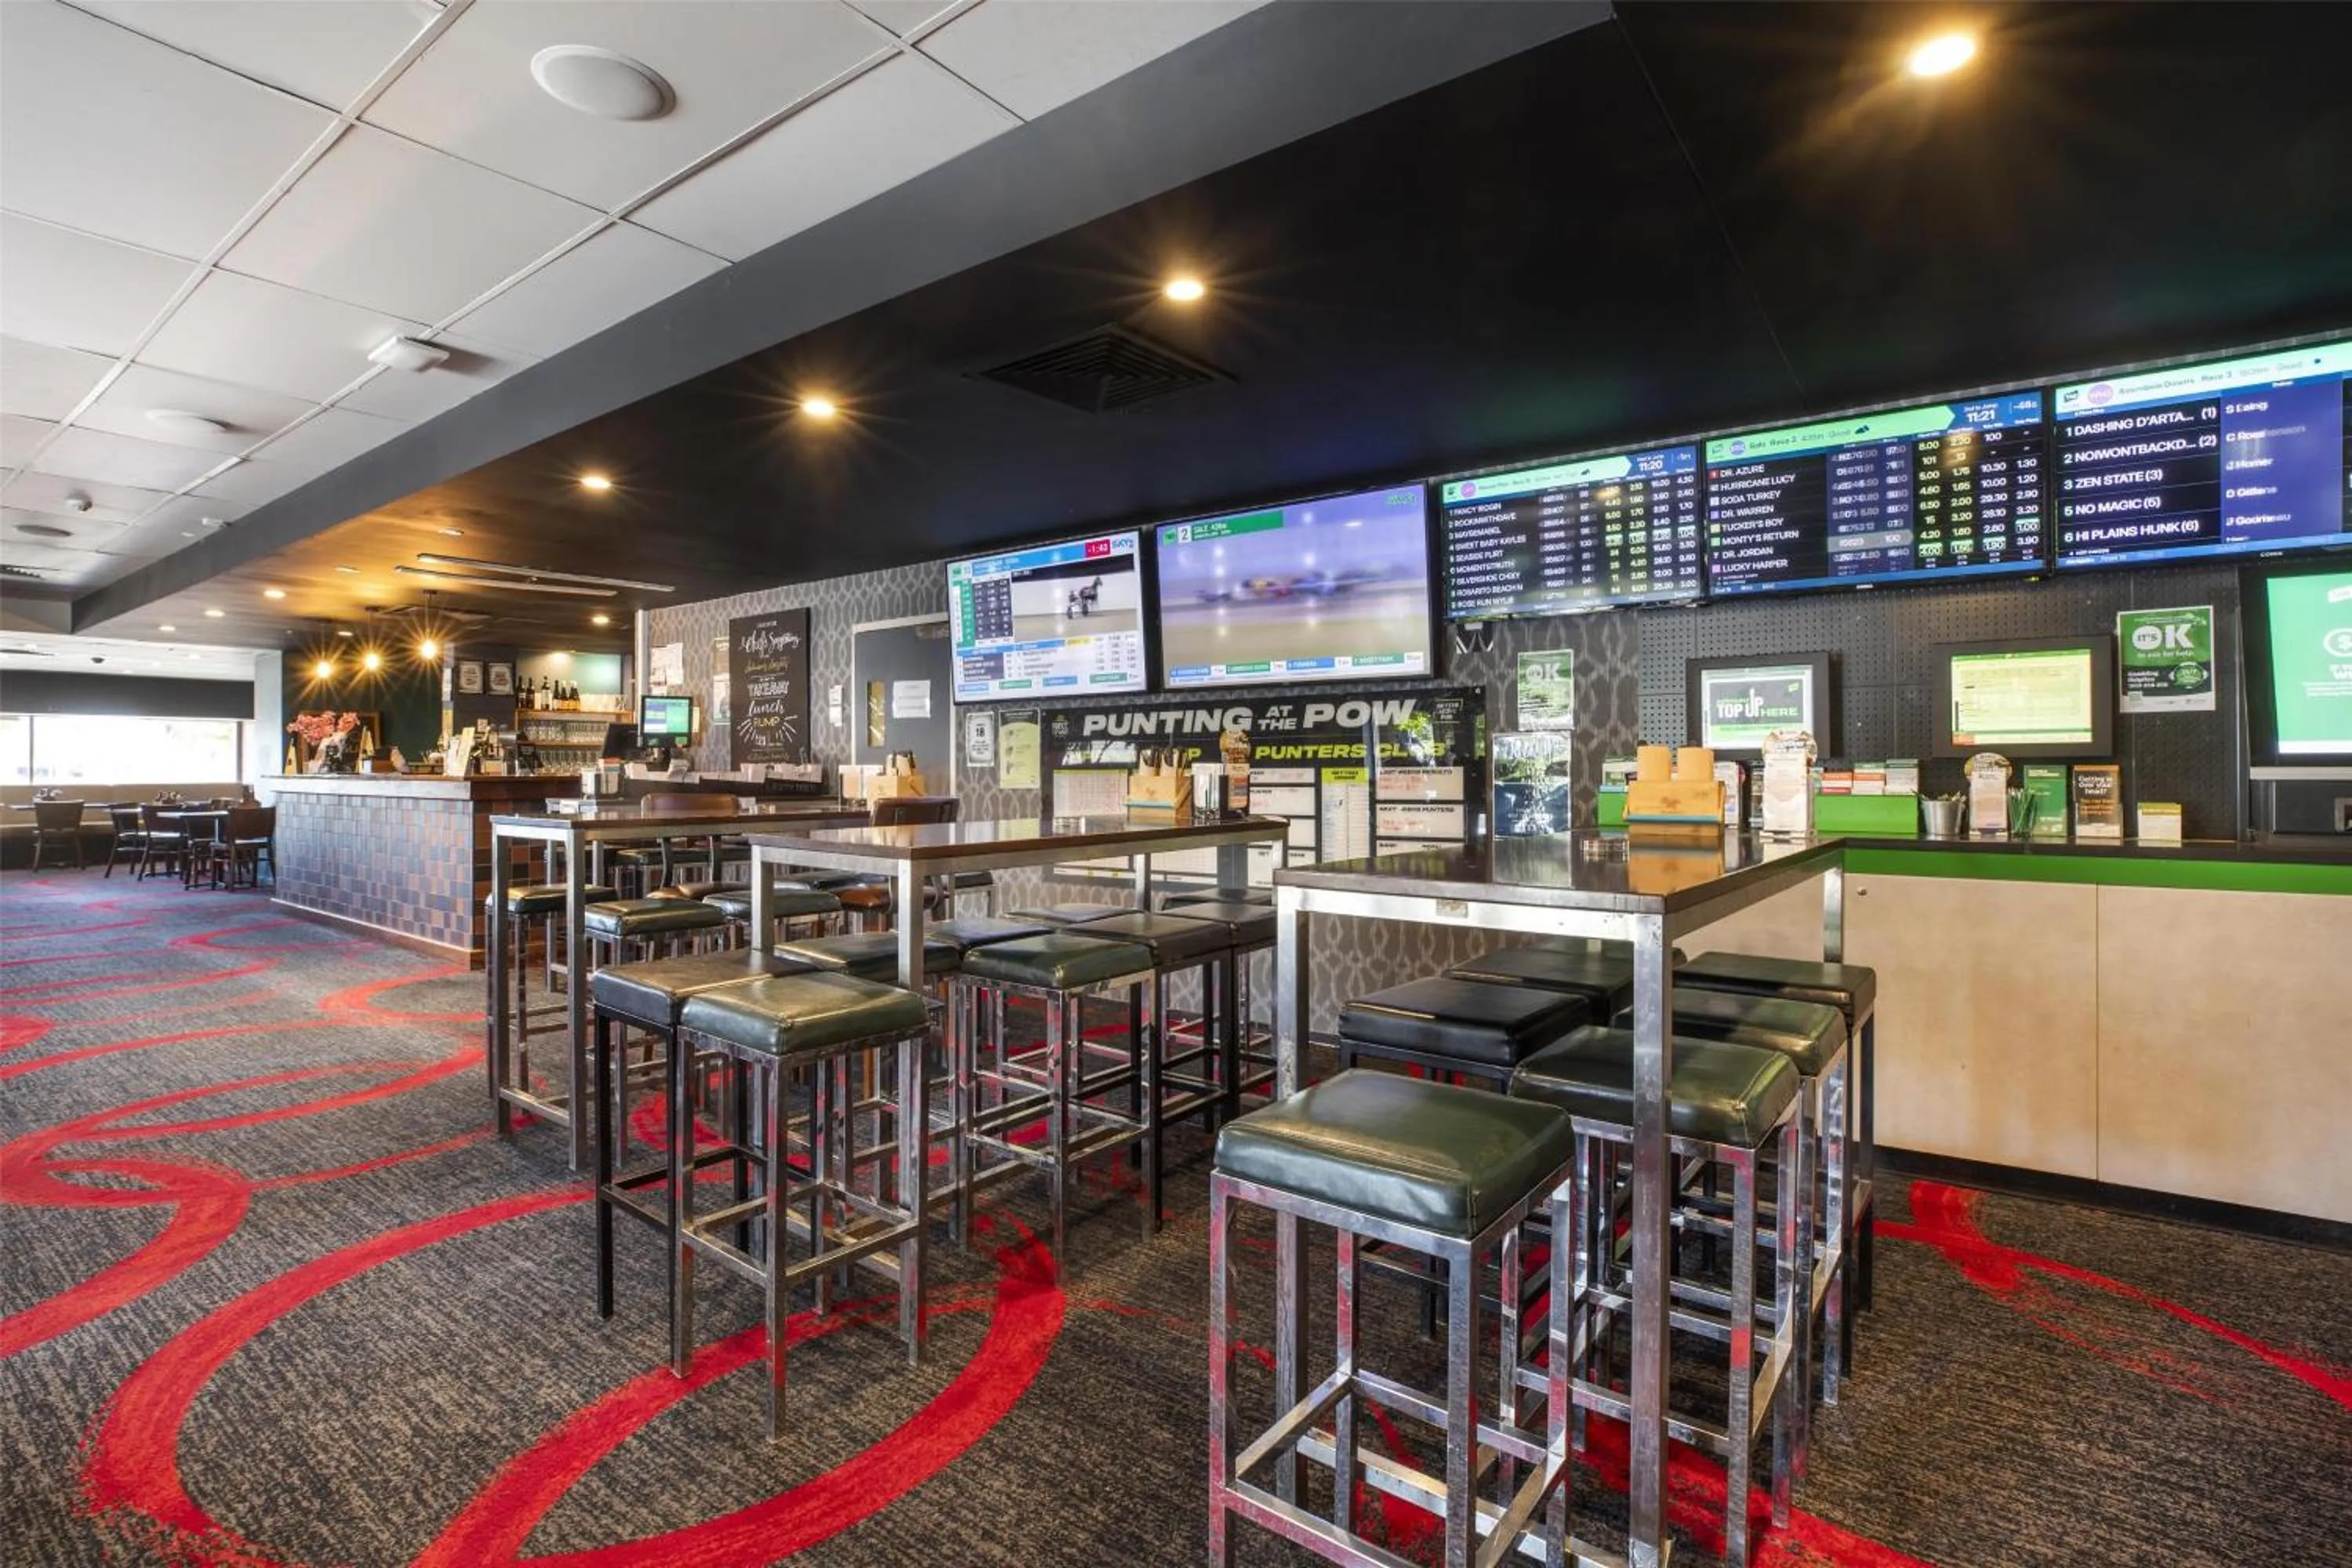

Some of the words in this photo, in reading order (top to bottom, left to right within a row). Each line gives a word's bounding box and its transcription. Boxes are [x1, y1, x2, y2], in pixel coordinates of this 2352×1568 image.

[1967, 410, 1995, 423] 11:21
[2066, 427, 2071, 437] 1
[2074, 418, 2133, 436] DASHING
[2201, 407, 2216, 420] (1)
[1736, 464, 1765, 476] AZURE
[1918, 441, 1940, 451] 8.00
[1985, 433, 2002, 441] 100
[2063, 454, 2072, 464] 2
[2199, 434, 2216, 448] (2)
[1639, 460, 1663, 471] 11:20
[1720, 477, 1769, 492] HURRICANE
[1771, 474, 1796, 485] LUCY
[1747, 490, 1781, 502] TURKEY
[2017, 459, 2037, 468] 1.30
[2075, 476, 2102, 489] ZEN
[2103, 471, 2144, 486] STATE
[2146, 469, 2163, 482] (3)
[1737, 505, 1774, 517] WARREN
[2016, 474, 2037, 484] 1.20
[2075, 504, 2096, 514] NO
[2098, 499, 2143, 513] MAGIC
[1765, 517, 1784, 528] BOY
[1181, 528, 1189, 540] 2
[1763, 530, 1799, 542] RETURN
[2064, 532, 2073, 542] 6
[2076, 531, 2089, 541] HI
[2091, 526, 2137, 539] PLAINS
[2140, 521, 2180, 535] HUNK
[1737, 547, 1773, 557] JORDAN
[1722, 562, 1751, 572] LUCKY
[1752, 559, 1788, 570] HARPER
[2137, 633, 2158, 641] IT'S
[1717, 702, 1743, 718] TOP
[1745, 688, 1763, 717] UP
[1760, 707, 1799, 717] HERE
[1265, 706, 1294, 717] AT
[1303, 699, 1417, 728] POW
[1083, 707, 1254, 736] PUNTING
[1258, 717, 1297, 731] THE
[1255, 743, 1367, 759] PUNTERS
